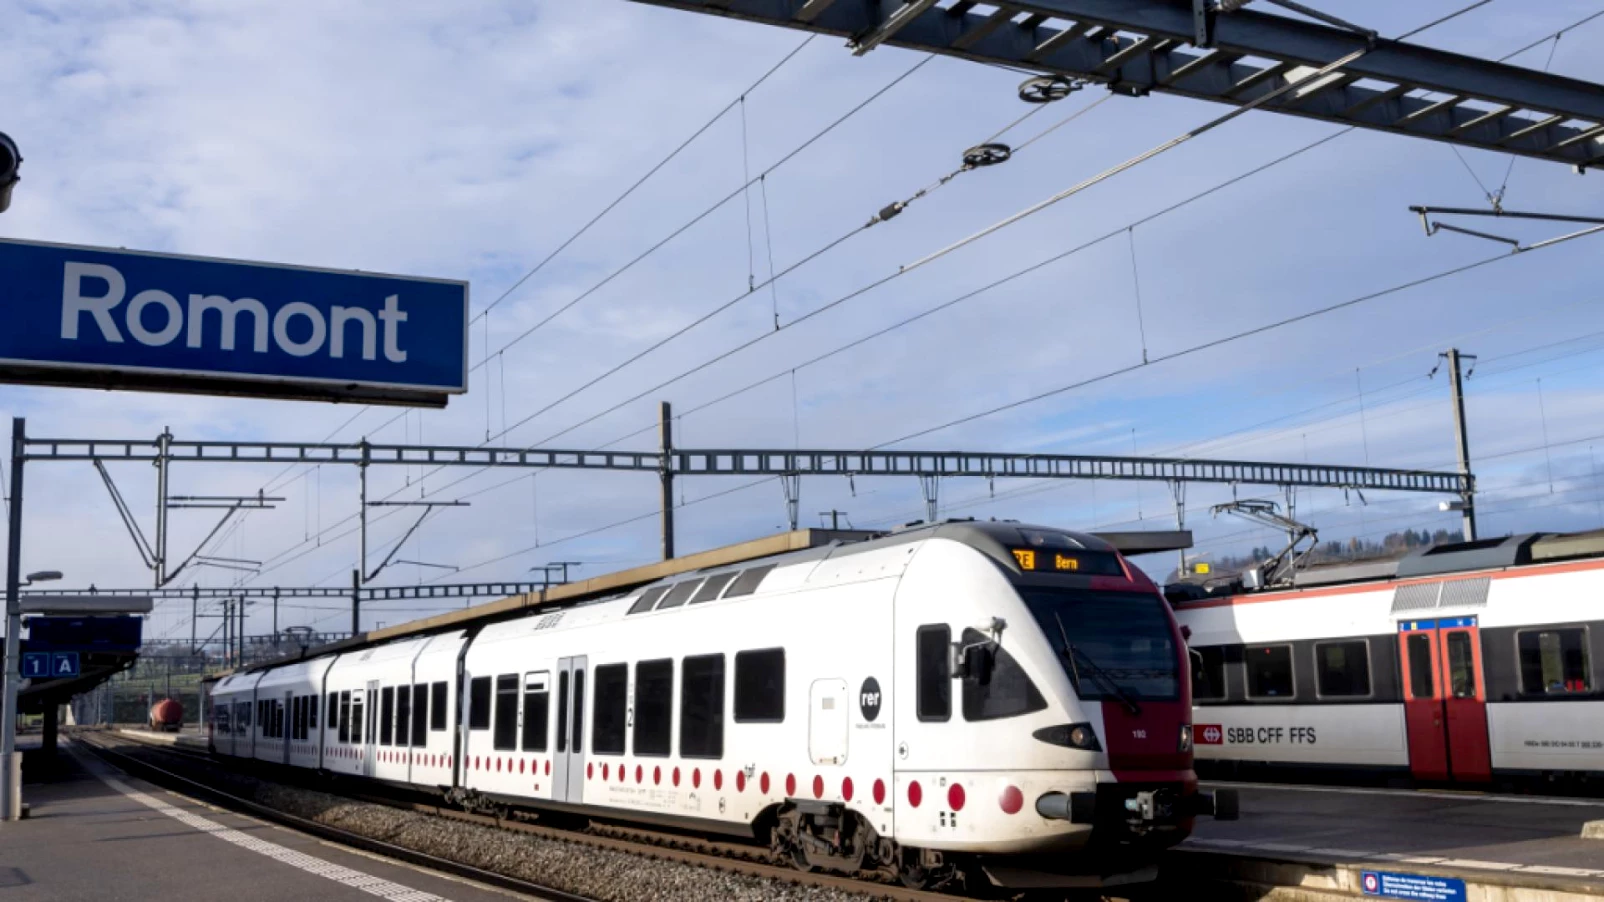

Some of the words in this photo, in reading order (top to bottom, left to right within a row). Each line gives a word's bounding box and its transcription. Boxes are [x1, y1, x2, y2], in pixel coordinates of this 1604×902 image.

[60, 261, 408, 363] Romont
[1055, 554, 1078, 569] Bern
[32, 659, 39, 673] 1
[59, 659, 71, 672] A
[862, 693, 879, 706] rer
[1227, 727, 1255, 743] SBB
[1257, 727, 1283, 743] CFF
[1289, 727, 1316, 744] FFS
